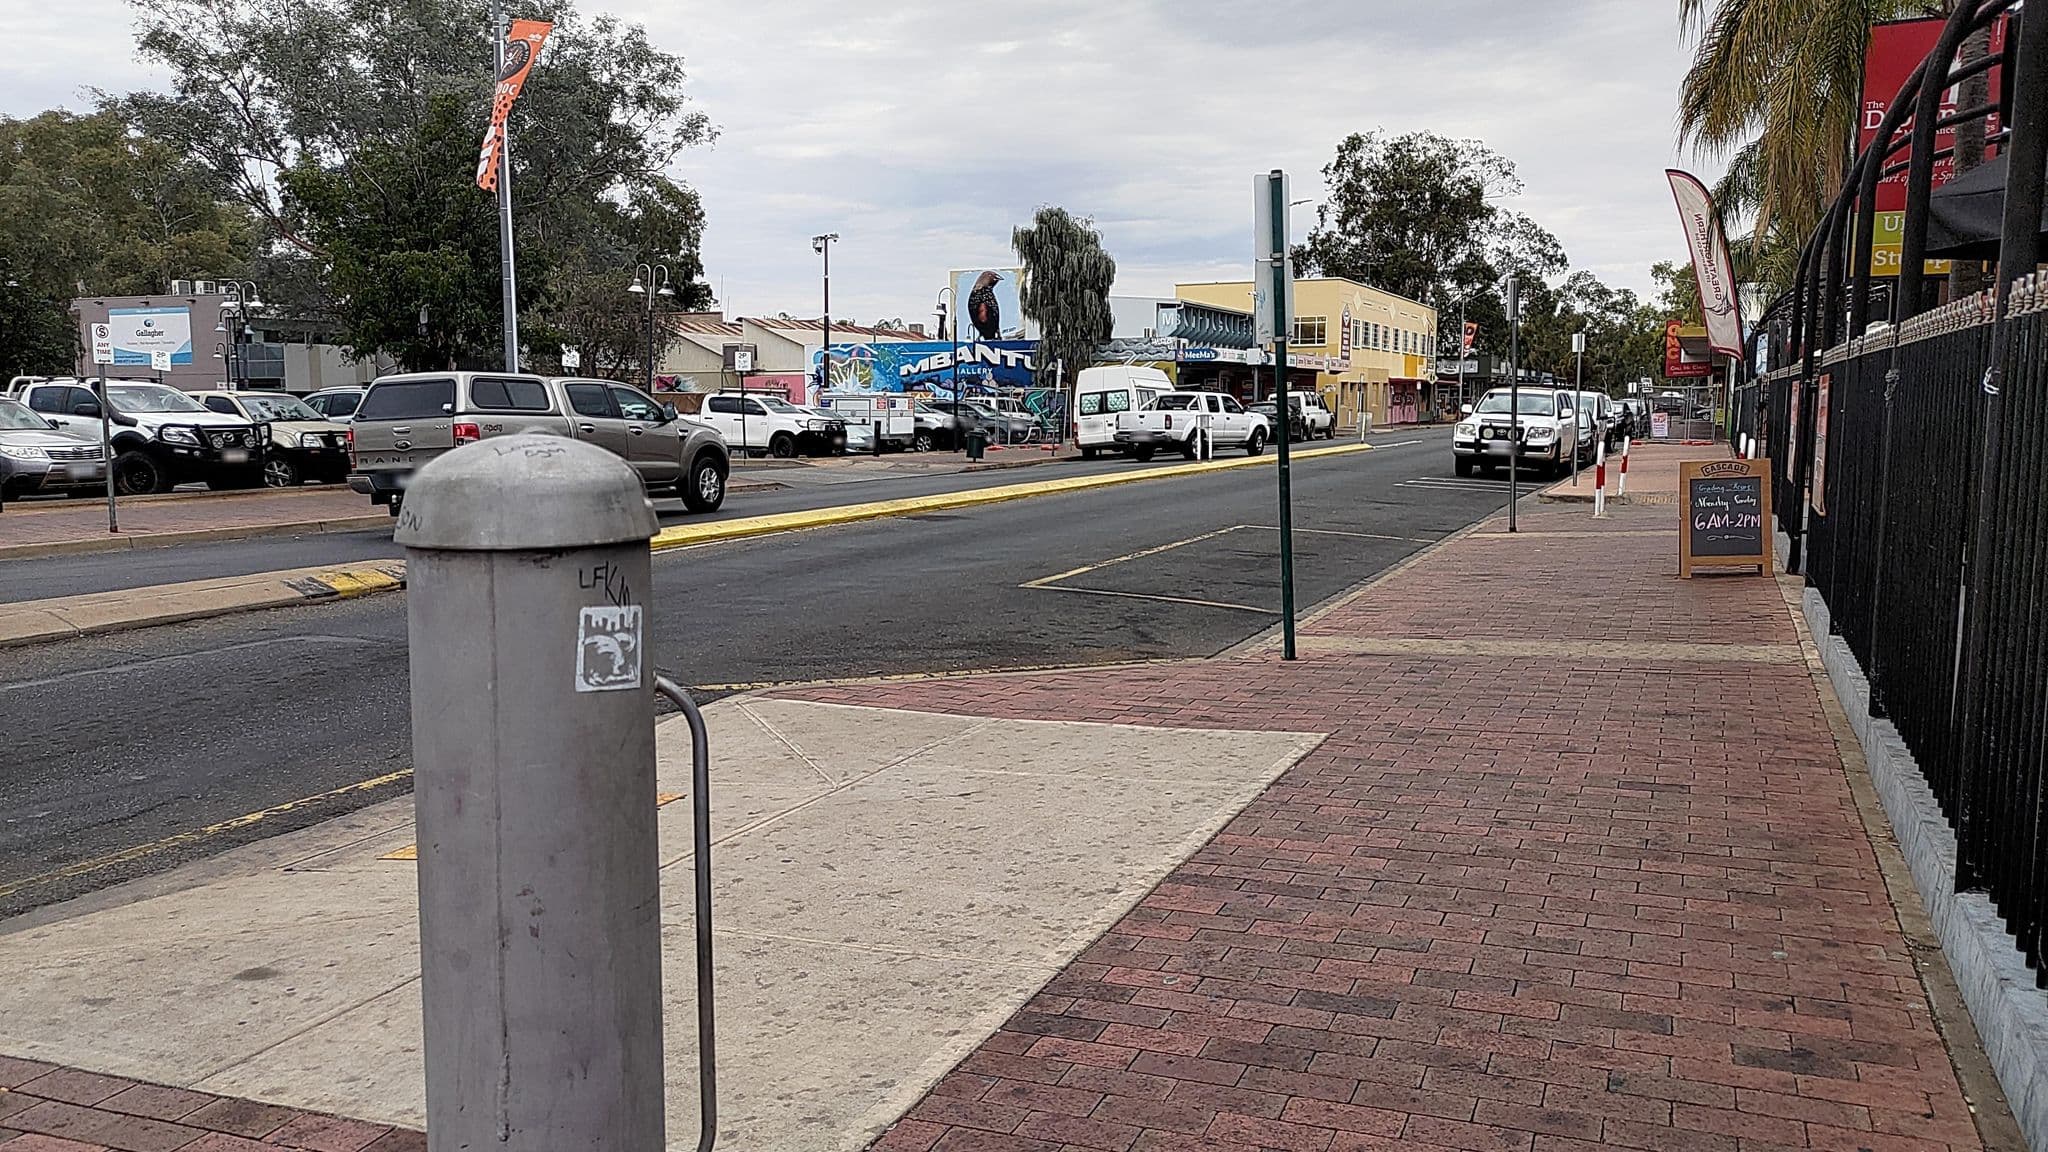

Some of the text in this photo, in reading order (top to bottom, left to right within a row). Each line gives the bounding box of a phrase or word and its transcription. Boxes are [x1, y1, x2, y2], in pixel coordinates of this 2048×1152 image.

[1866, 101, 1884, 109] The
[136, 329, 164, 339] Gallagher
[1185, 352, 1216, 361] MeeMa's
[1704, 463, 1746, 474] CASCADE
